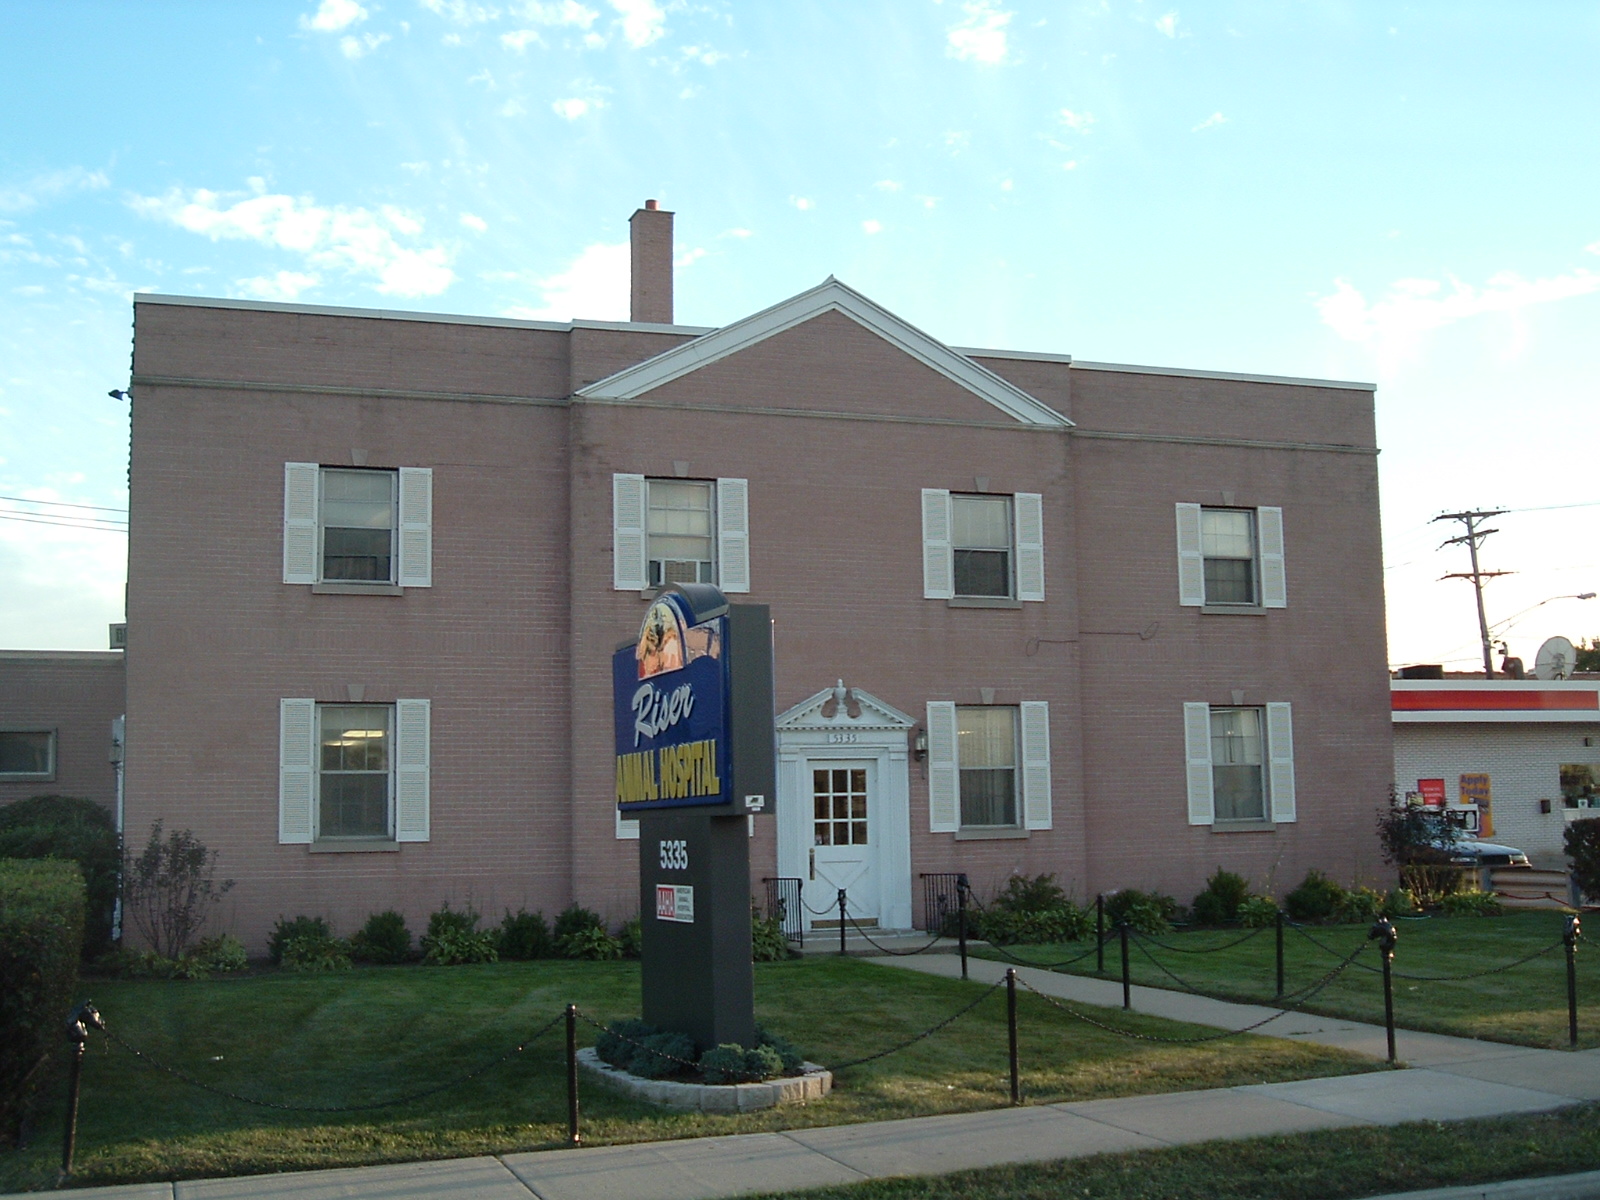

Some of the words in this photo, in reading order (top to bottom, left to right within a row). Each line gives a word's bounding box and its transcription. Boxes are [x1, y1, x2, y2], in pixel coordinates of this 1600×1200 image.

[632, 684, 694, 747] Riser
[833, 733, 857, 744] 5335
[616, 750, 658, 802] ANIMAL
[659, 739, 720, 799] HOSPITAL
[1460, 774, 1488, 785] Apply
[1461, 786, 1489, 796] Today
[660, 840, 688, 869] 5335
